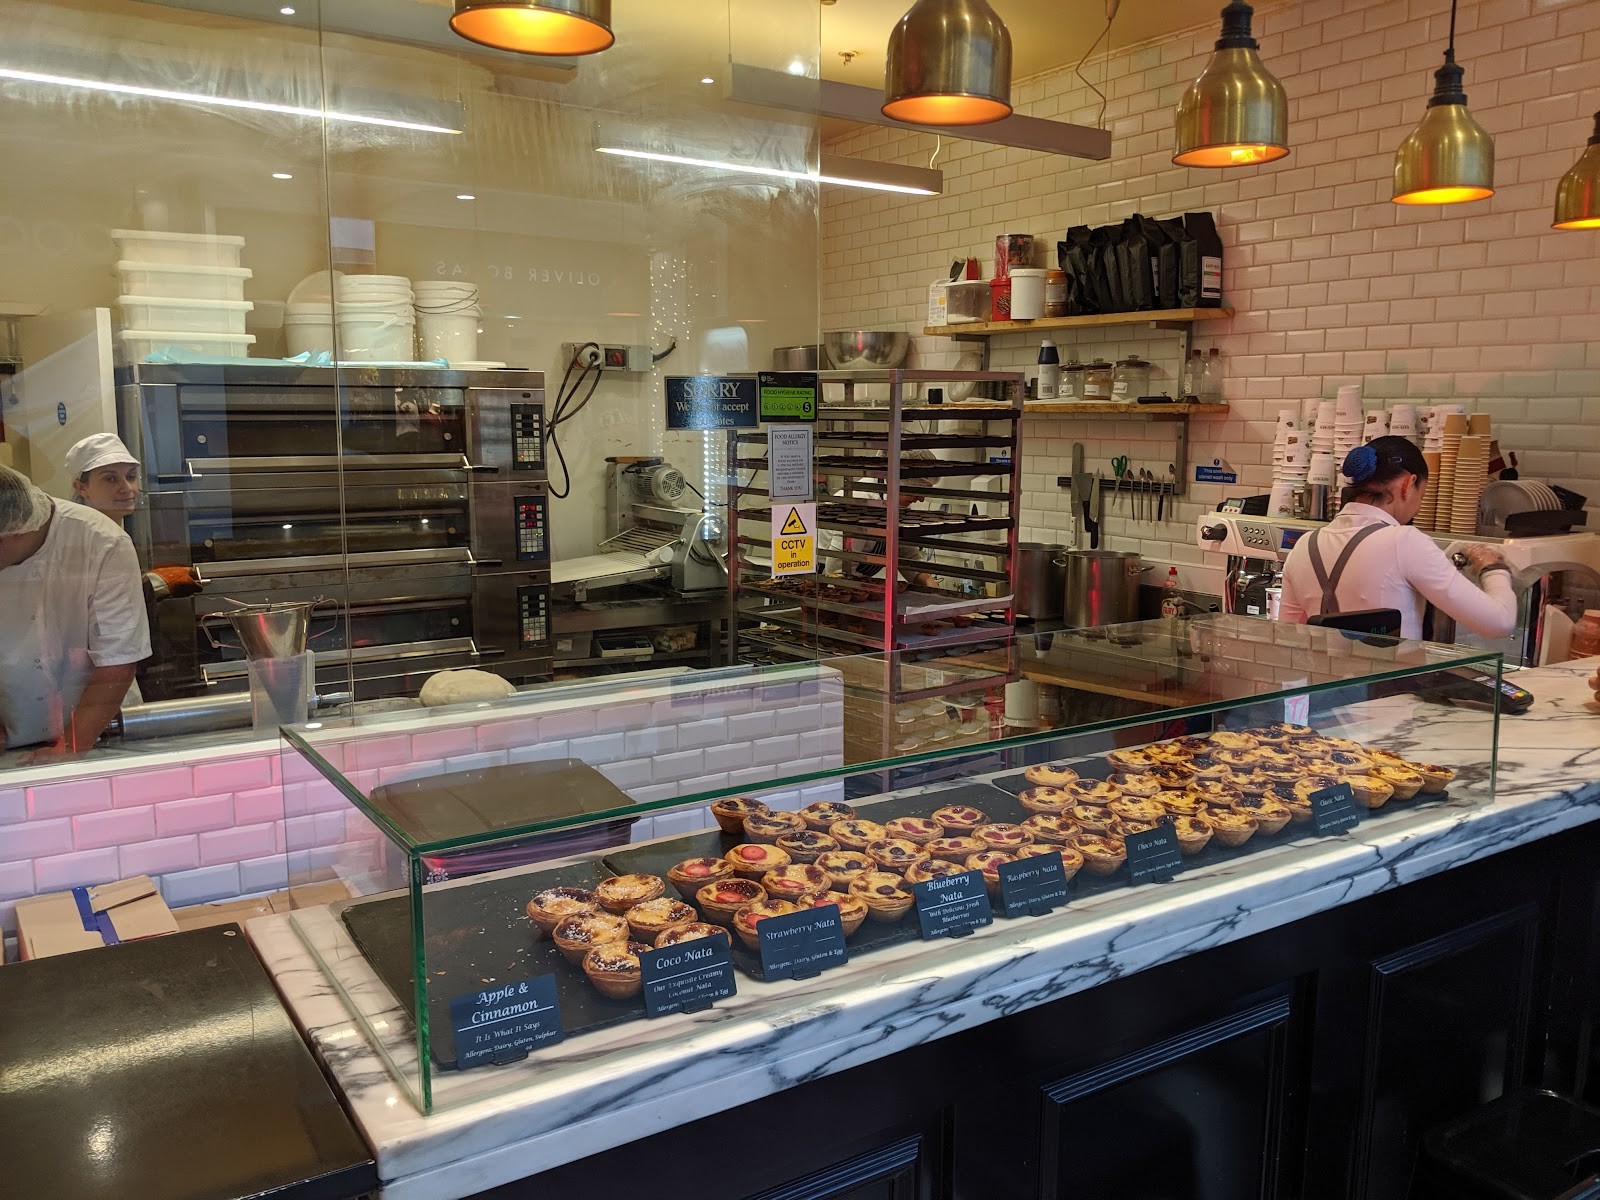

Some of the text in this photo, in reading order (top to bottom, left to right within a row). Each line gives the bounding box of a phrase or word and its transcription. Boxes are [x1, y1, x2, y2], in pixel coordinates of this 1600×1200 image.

[683, 381, 741, 398] SORRY
[722, 402, 750, 413] accept
[781, 539, 806, 550] CCTV
[777, 560, 810, 569] operation
[1042, 864, 1058, 873] Nata
[926, 875, 970, 891] Blueberry
[940, 891, 963, 903] Nata
[765, 919, 836, 940] Strawberry Nata
[656, 947, 714, 970] Coco Nata
[698, 969, 723, 981] Creamy
[695, 981, 712, 992] Nata
[476, 982, 529, 1007] Apple &
[471, 999, 539, 1024] Cinnamon
[475, 1035, 482, 1044] It
[484, 1032, 491, 1041] Is
[493, 1028, 514, 1039] What
[523, 1021, 541, 1031] Says
